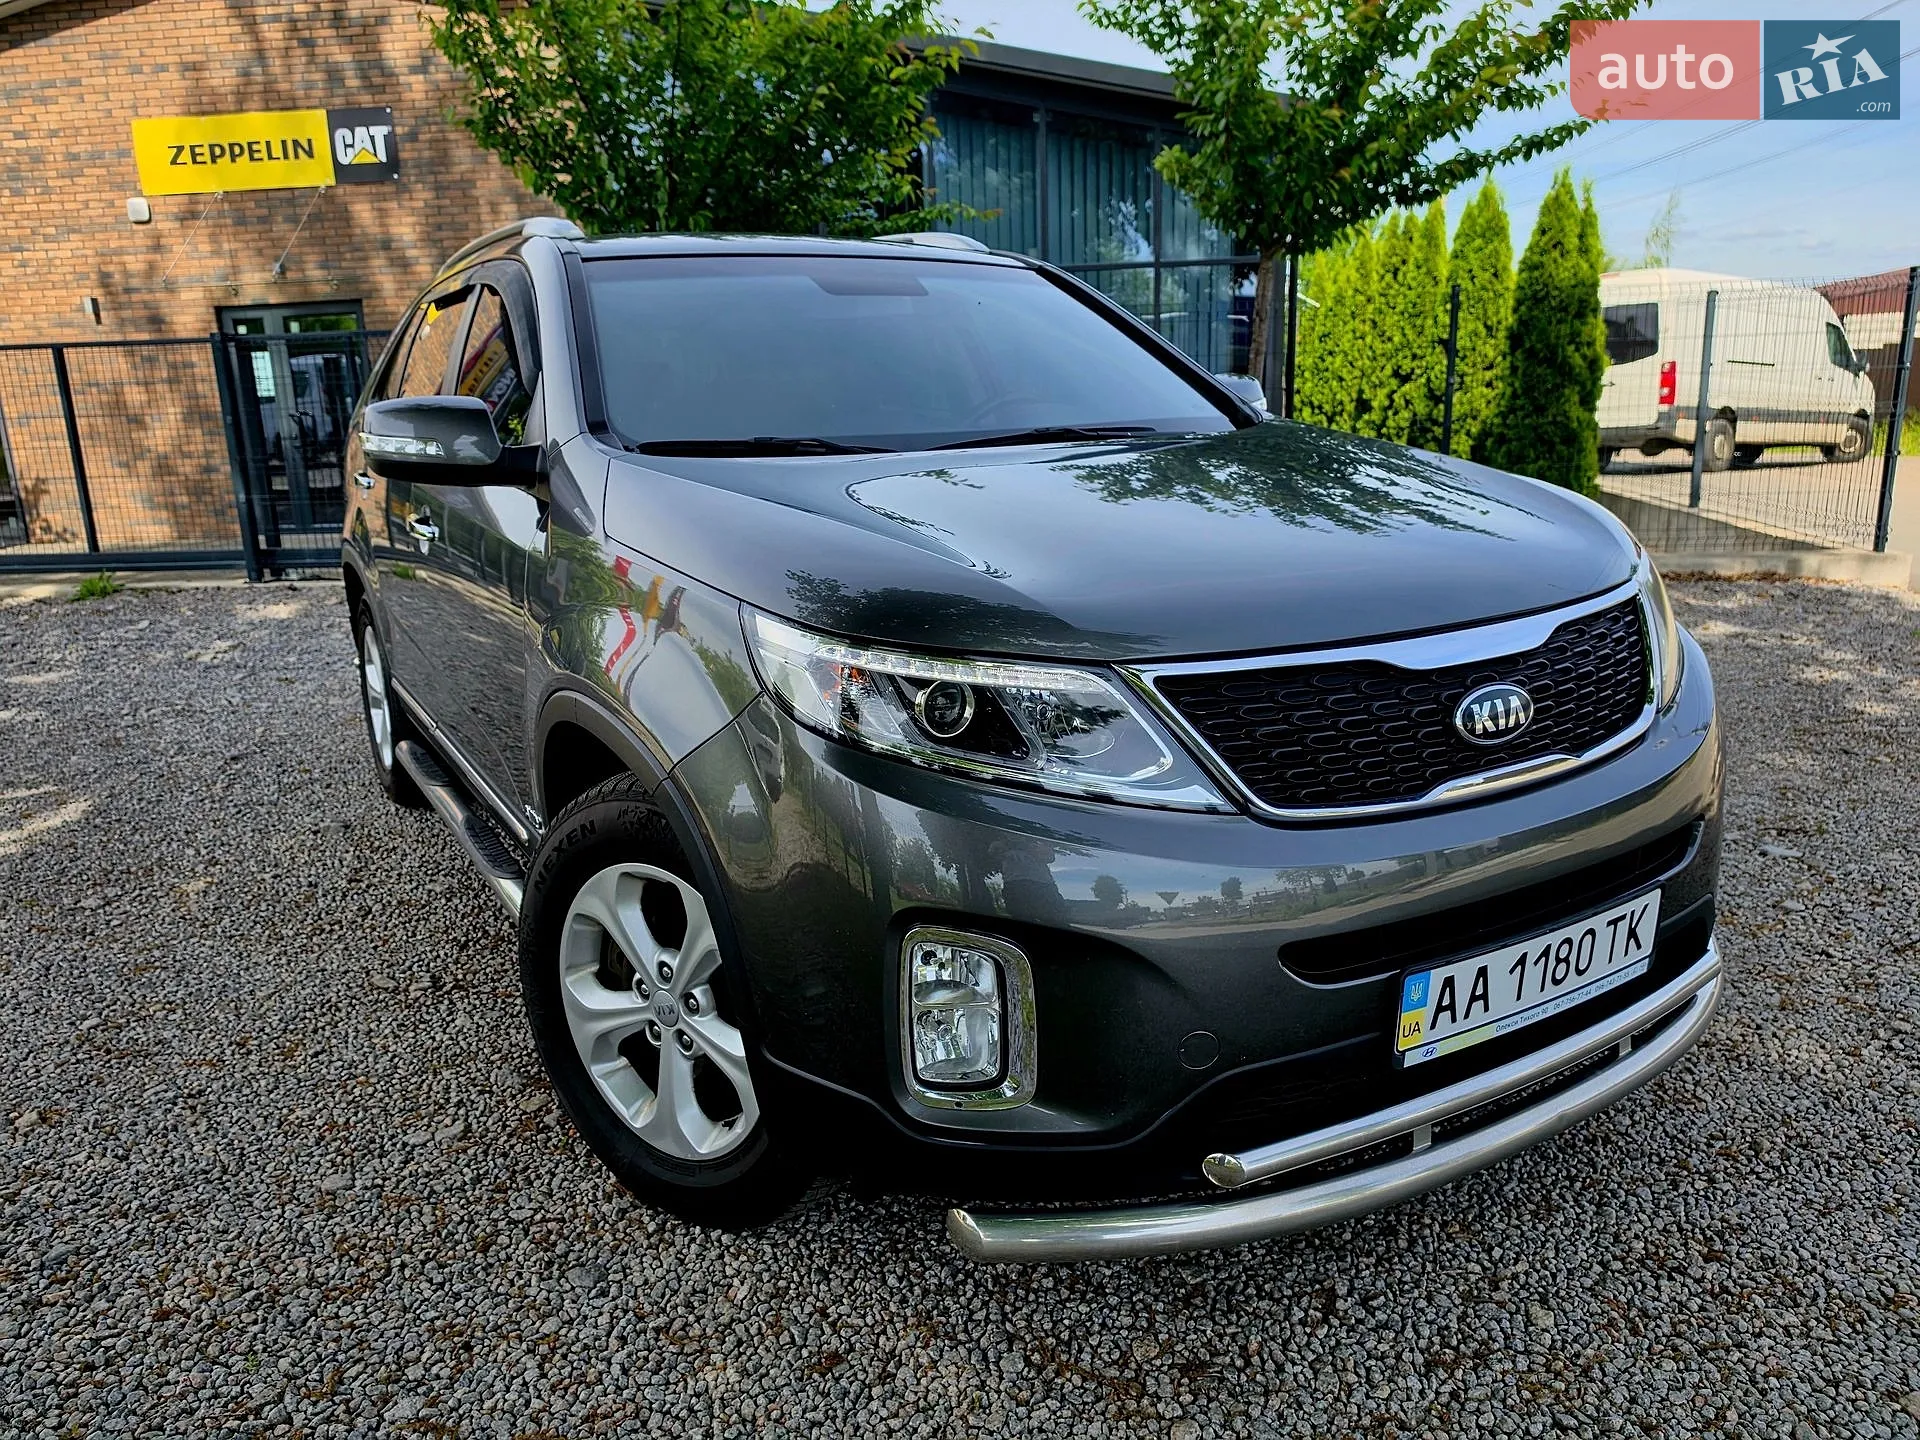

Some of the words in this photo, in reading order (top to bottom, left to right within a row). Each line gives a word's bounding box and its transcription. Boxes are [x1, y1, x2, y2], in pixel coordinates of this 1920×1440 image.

[168, 138, 314, 166] ZEPPELIN
[334, 125, 389, 165] CAT
[1471, 695, 1526, 734] KIA
[534, 819, 597, 892] NEXEN
[1429, 964, 1489, 1031] AA
[1508, 928, 1597, 1002] 1180
[1606, 902, 1649, 964] TK
[1402, 1021, 1421, 1039] UA
